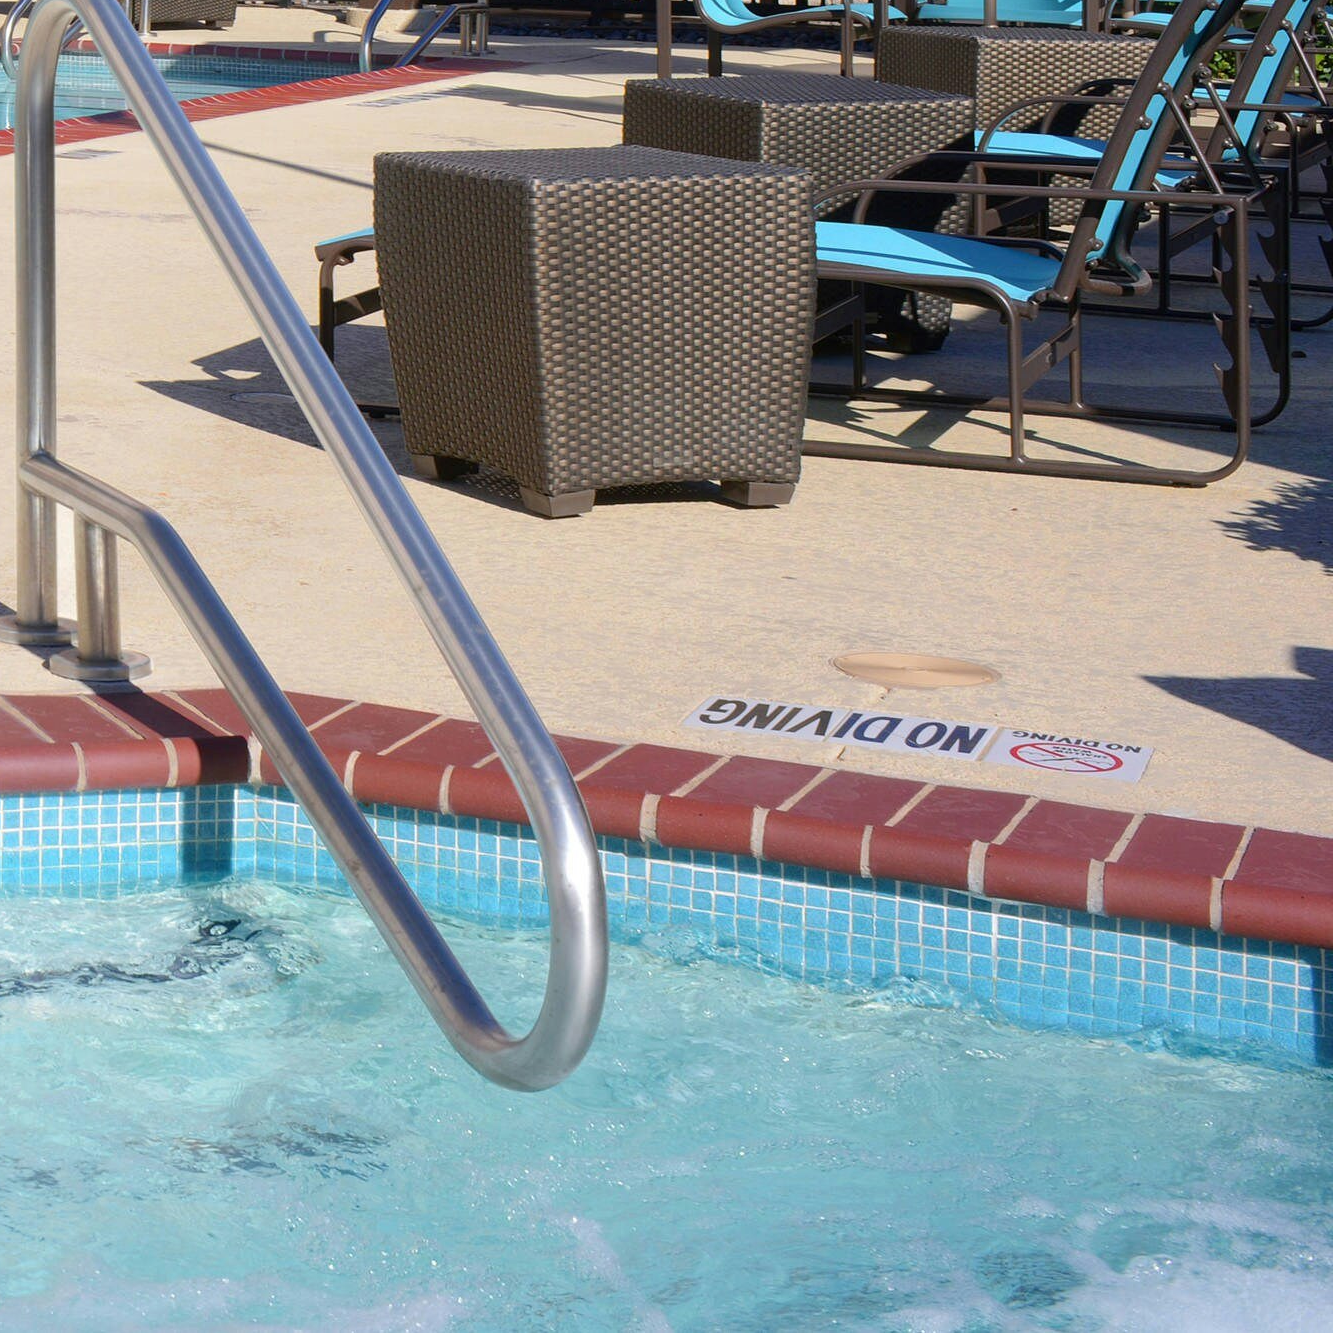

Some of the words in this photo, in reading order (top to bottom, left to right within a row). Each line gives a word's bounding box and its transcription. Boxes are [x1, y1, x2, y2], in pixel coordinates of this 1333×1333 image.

[699, 698, 903, 743] DIVING
[905, 721, 988, 754] NO
[1012, 730, 1100, 747] DIVING
[1106, 743, 1142, 754] NO
